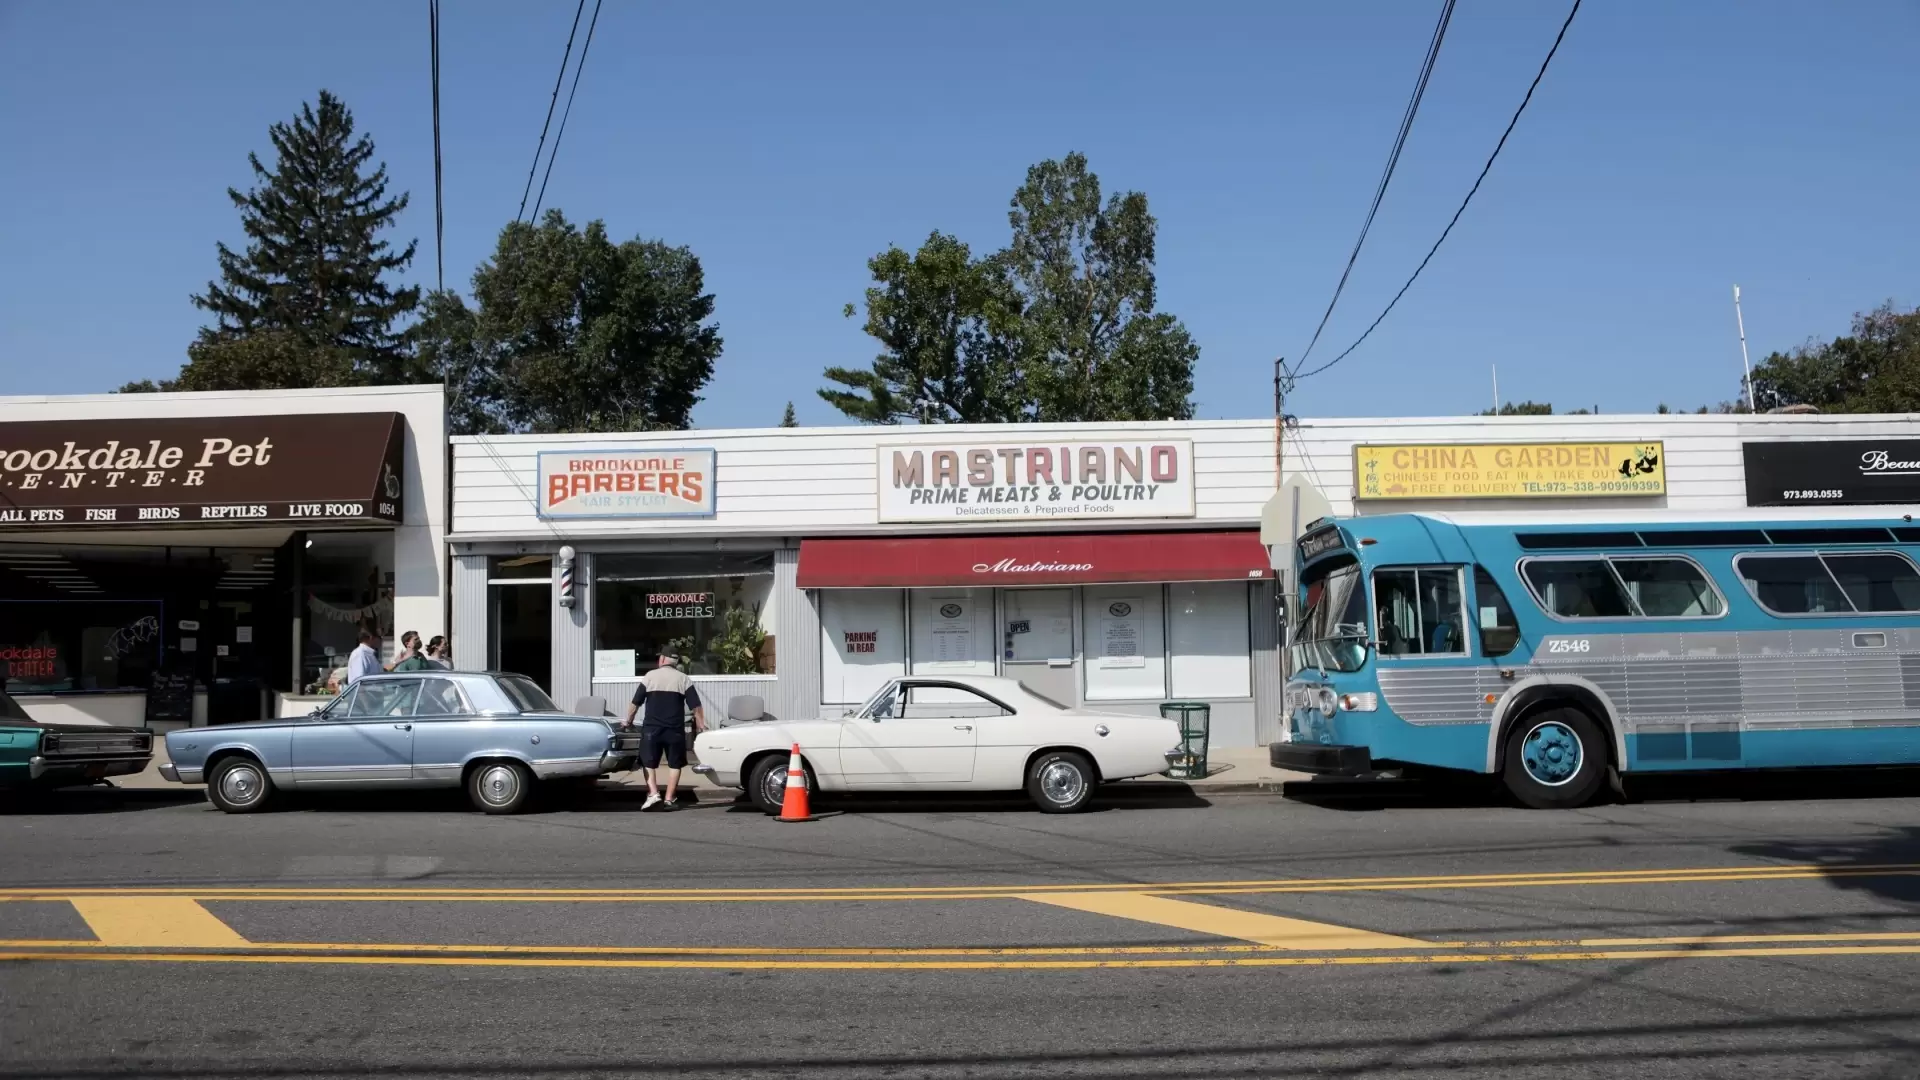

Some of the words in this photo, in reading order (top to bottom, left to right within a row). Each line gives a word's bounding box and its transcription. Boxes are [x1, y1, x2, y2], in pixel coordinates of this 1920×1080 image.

[195, 436, 273, 468] Pet
[1392, 448, 1478, 469] CHINA
[1495, 446, 1610, 468] GARDEN
[569, 458, 685, 472] BROOKDALE
[892, 445, 1178, 488] MASTRIANO
[1384, 472, 1437, 482] CHINESE
[1445, 471, 1479, 481] FOOD
[1486, 471, 1508, 481] EAT
[1517, 470, 1528, 480] IN
[1536, 470, 1544, 480] &
[1553, 469, 1584, 480] TAKE
[1592, 469, 1617, 479] OUT
[548, 472, 703, 508] BARBERS
[910, 487, 969, 504] PRIME
[977, 485, 1040, 503] MEATS
[1047, 486, 1062, 501] &
[1071, 484, 1160, 501] POULTRY
[1411, 484, 1446, 494] FREE
[1453, 483, 1517, 493] DELIVERY
[1783, 490, 1843, 499] 973.893.0555
[30, 509, 64, 521] PETS
[85, 509, 117, 520] FISH
[138, 507, 180, 519] BIRDS
[201, 505, 267, 519] REPTILES
[288, 504, 321, 517] LIVE
[325, 503, 363, 516] FOOD
[379, 502, 395, 515] 1054
[955, 506, 1019, 515] Delicatessen
[1023, 506, 1031, 514] &
[1035, 505, 1080, 516] Prepared
[1084, 504, 1115, 513] Foods
[972, 558, 1094, 573] Mastriano
[649, 593, 706, 604] BROOKDALE
[646, 606, 714, 618] BARBERS
[1010, 622, 1030, 633] OPEN
[844, 631, 877, 642] PARKING
[0, 644, 57, 660] okdale
[847, 643, 855, 653] IN
[856, 643, 875, 653] REAR
[1549, 639, 1590, 653] Z546
[9, 660, 55, 677] CENTER
